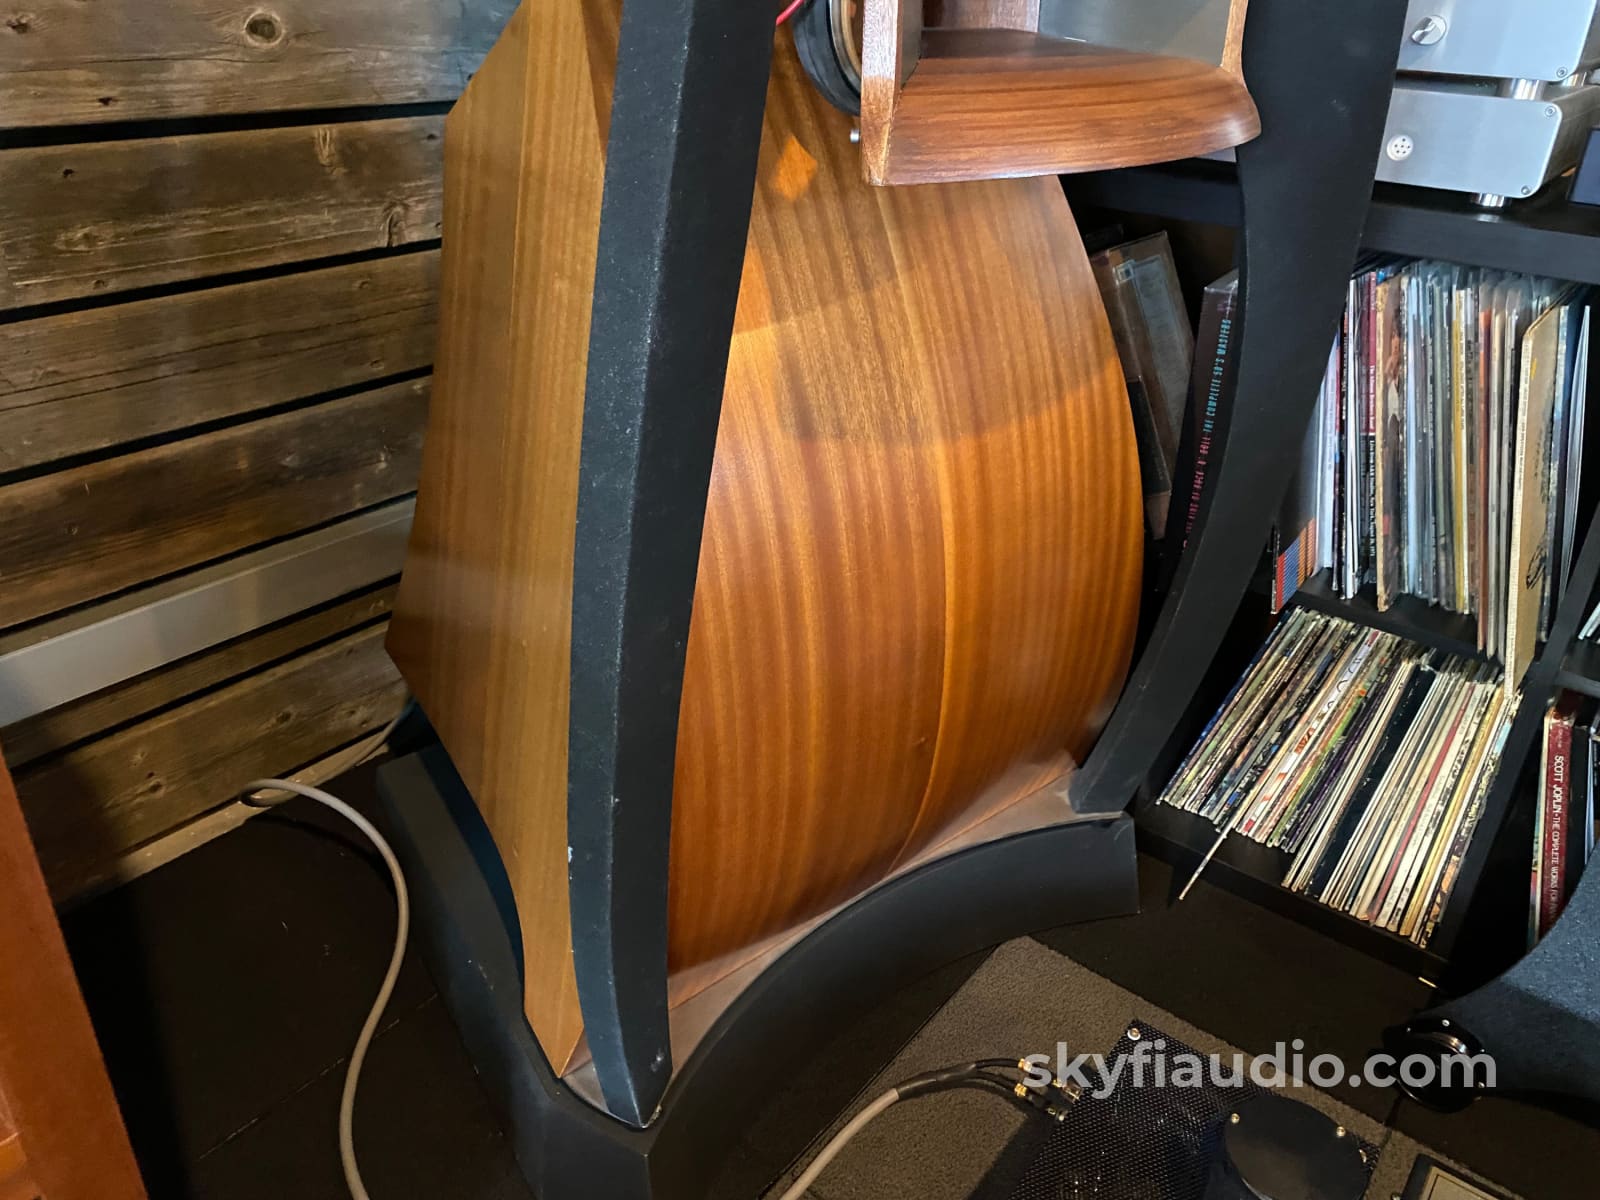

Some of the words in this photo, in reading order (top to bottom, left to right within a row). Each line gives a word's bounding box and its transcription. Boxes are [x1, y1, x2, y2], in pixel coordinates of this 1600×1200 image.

[1205, 378, 1222, 417] COMPLETE
[1216, 319, 1232, 356] MASTERS
[1554, 755, 1564, 783] SCOTT
[1552, 784, 1563, 814] JOPLIN
[1552, 816, 1561, 830] THE
[1551, 831, 1560, 864] COMPLETE
[1550, 866, 1559, 888] WORKS
